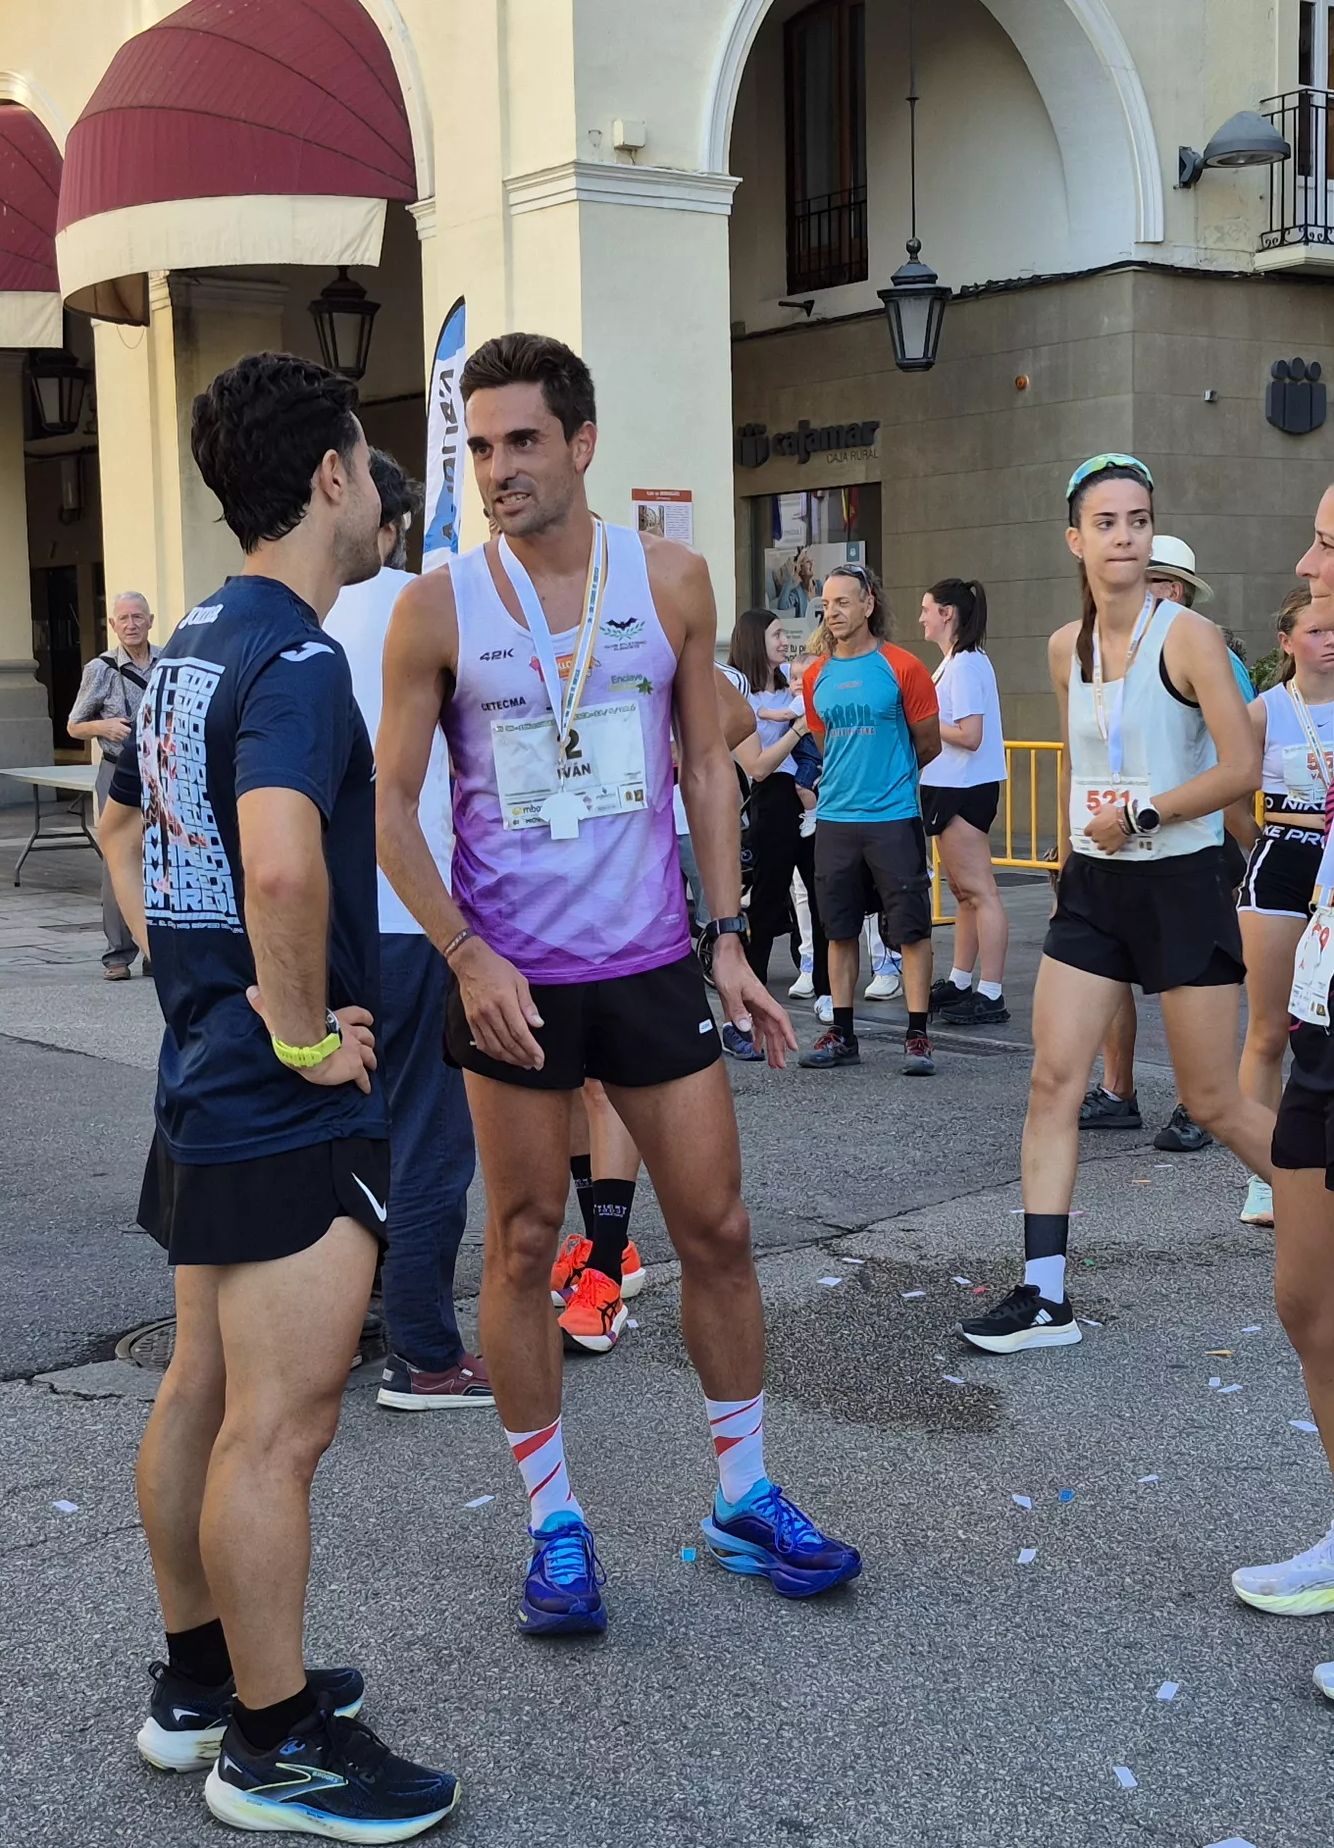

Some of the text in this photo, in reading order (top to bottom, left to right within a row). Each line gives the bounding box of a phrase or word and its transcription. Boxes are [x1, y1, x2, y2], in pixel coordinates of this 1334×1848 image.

[772, 419, 880, 465] cajamar
[826, 448, 879, 464] CAJA RURAL
[479, 648, 515, 661] 42K
[481, 696, 527, 712] CETECMA
[557, 728, 582, 760] 2
[556, 761, 592, 780] IVÁN
